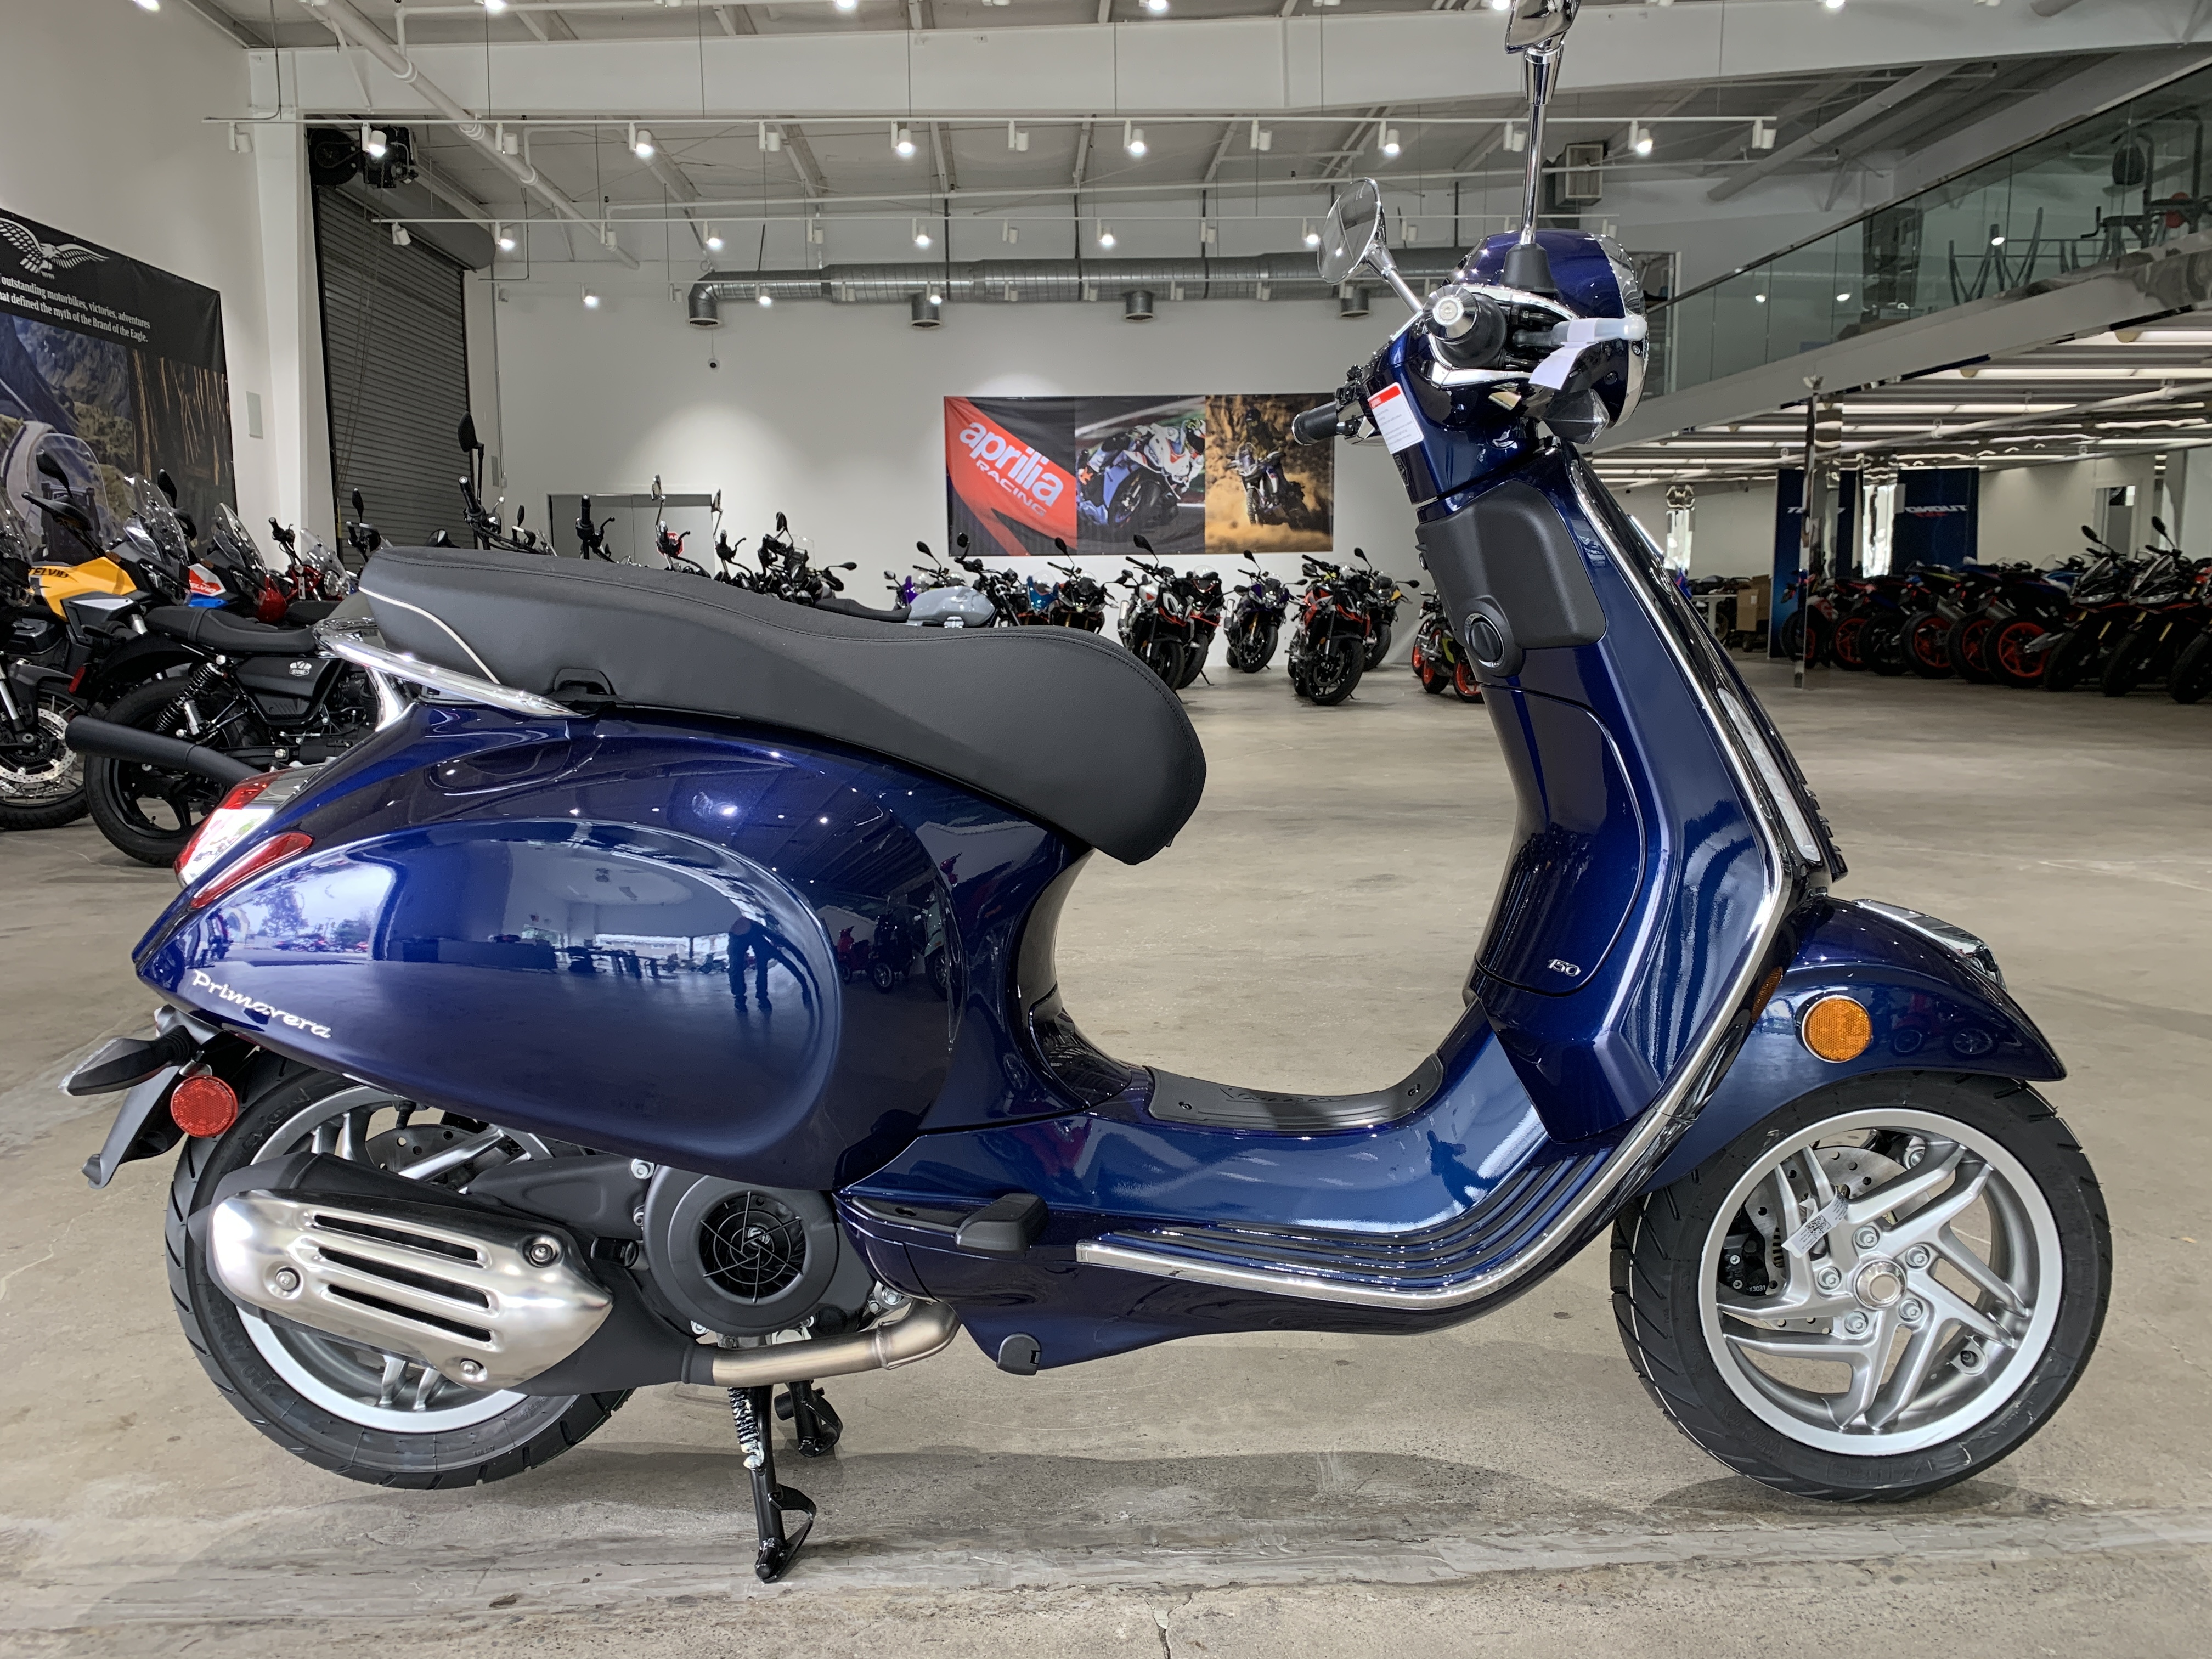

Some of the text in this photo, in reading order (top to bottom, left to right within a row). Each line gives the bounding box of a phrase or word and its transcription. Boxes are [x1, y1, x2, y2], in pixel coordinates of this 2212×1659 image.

[1, 276, 150, 329] outstanding motorbikes, victories, adventures
[11, 292, 40, 311] defined
[40, 301, 52, 314] the
[53, 307, 72, 320] myth
[72, 312, 81, 323] of
[81, 314, 92, 326] the
[92, 317, 112, 332] Brand
[112, 324, 119, 334] of
[119, 325, 129, 337] the
[130, 328, 148, 342] Eagle.
[960, 422, 1064, 507] aprilia
[976, 460, 1047, 517] RACING
[27, 567, 69, 578] TELVIO
[1547, 959, 1581, 977] 150
[193, 969, 331, 1039] Primavera
